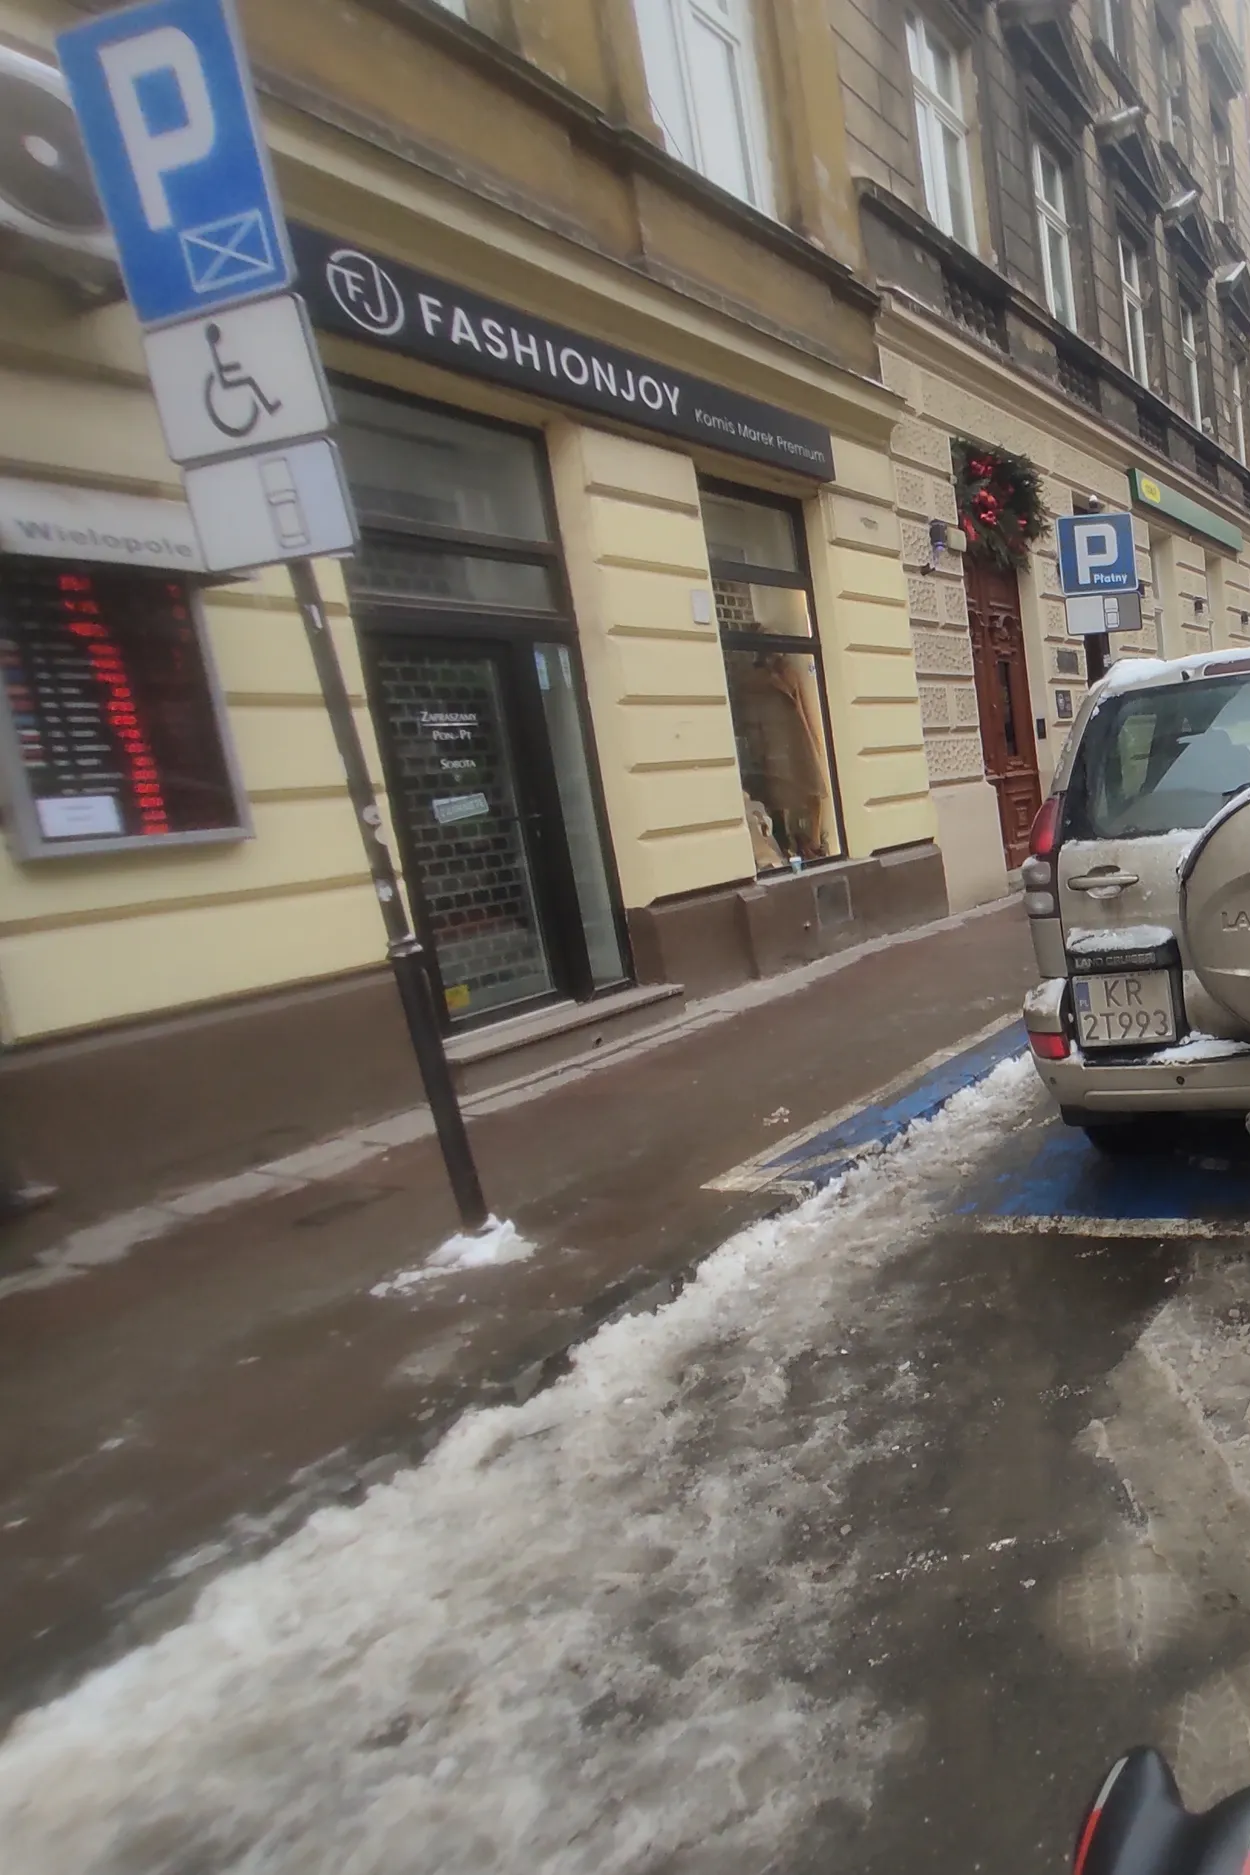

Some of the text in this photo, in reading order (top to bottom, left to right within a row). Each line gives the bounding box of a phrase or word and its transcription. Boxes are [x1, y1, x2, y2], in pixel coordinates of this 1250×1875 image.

[98, 26, 215, 233] P
[418, 293, 680, 416] FASHIONJOY
[694, 408, 826, 463] Komis Marek Premium
[14, 517, 193, 558] Wielopole
[1074, 523, 1119, 585] P
[1093, 573, 1128, 584] Płatny
[1104, 979, 1143, 1008] KR
[1083, 1009, 1169, 1041] 2T993
